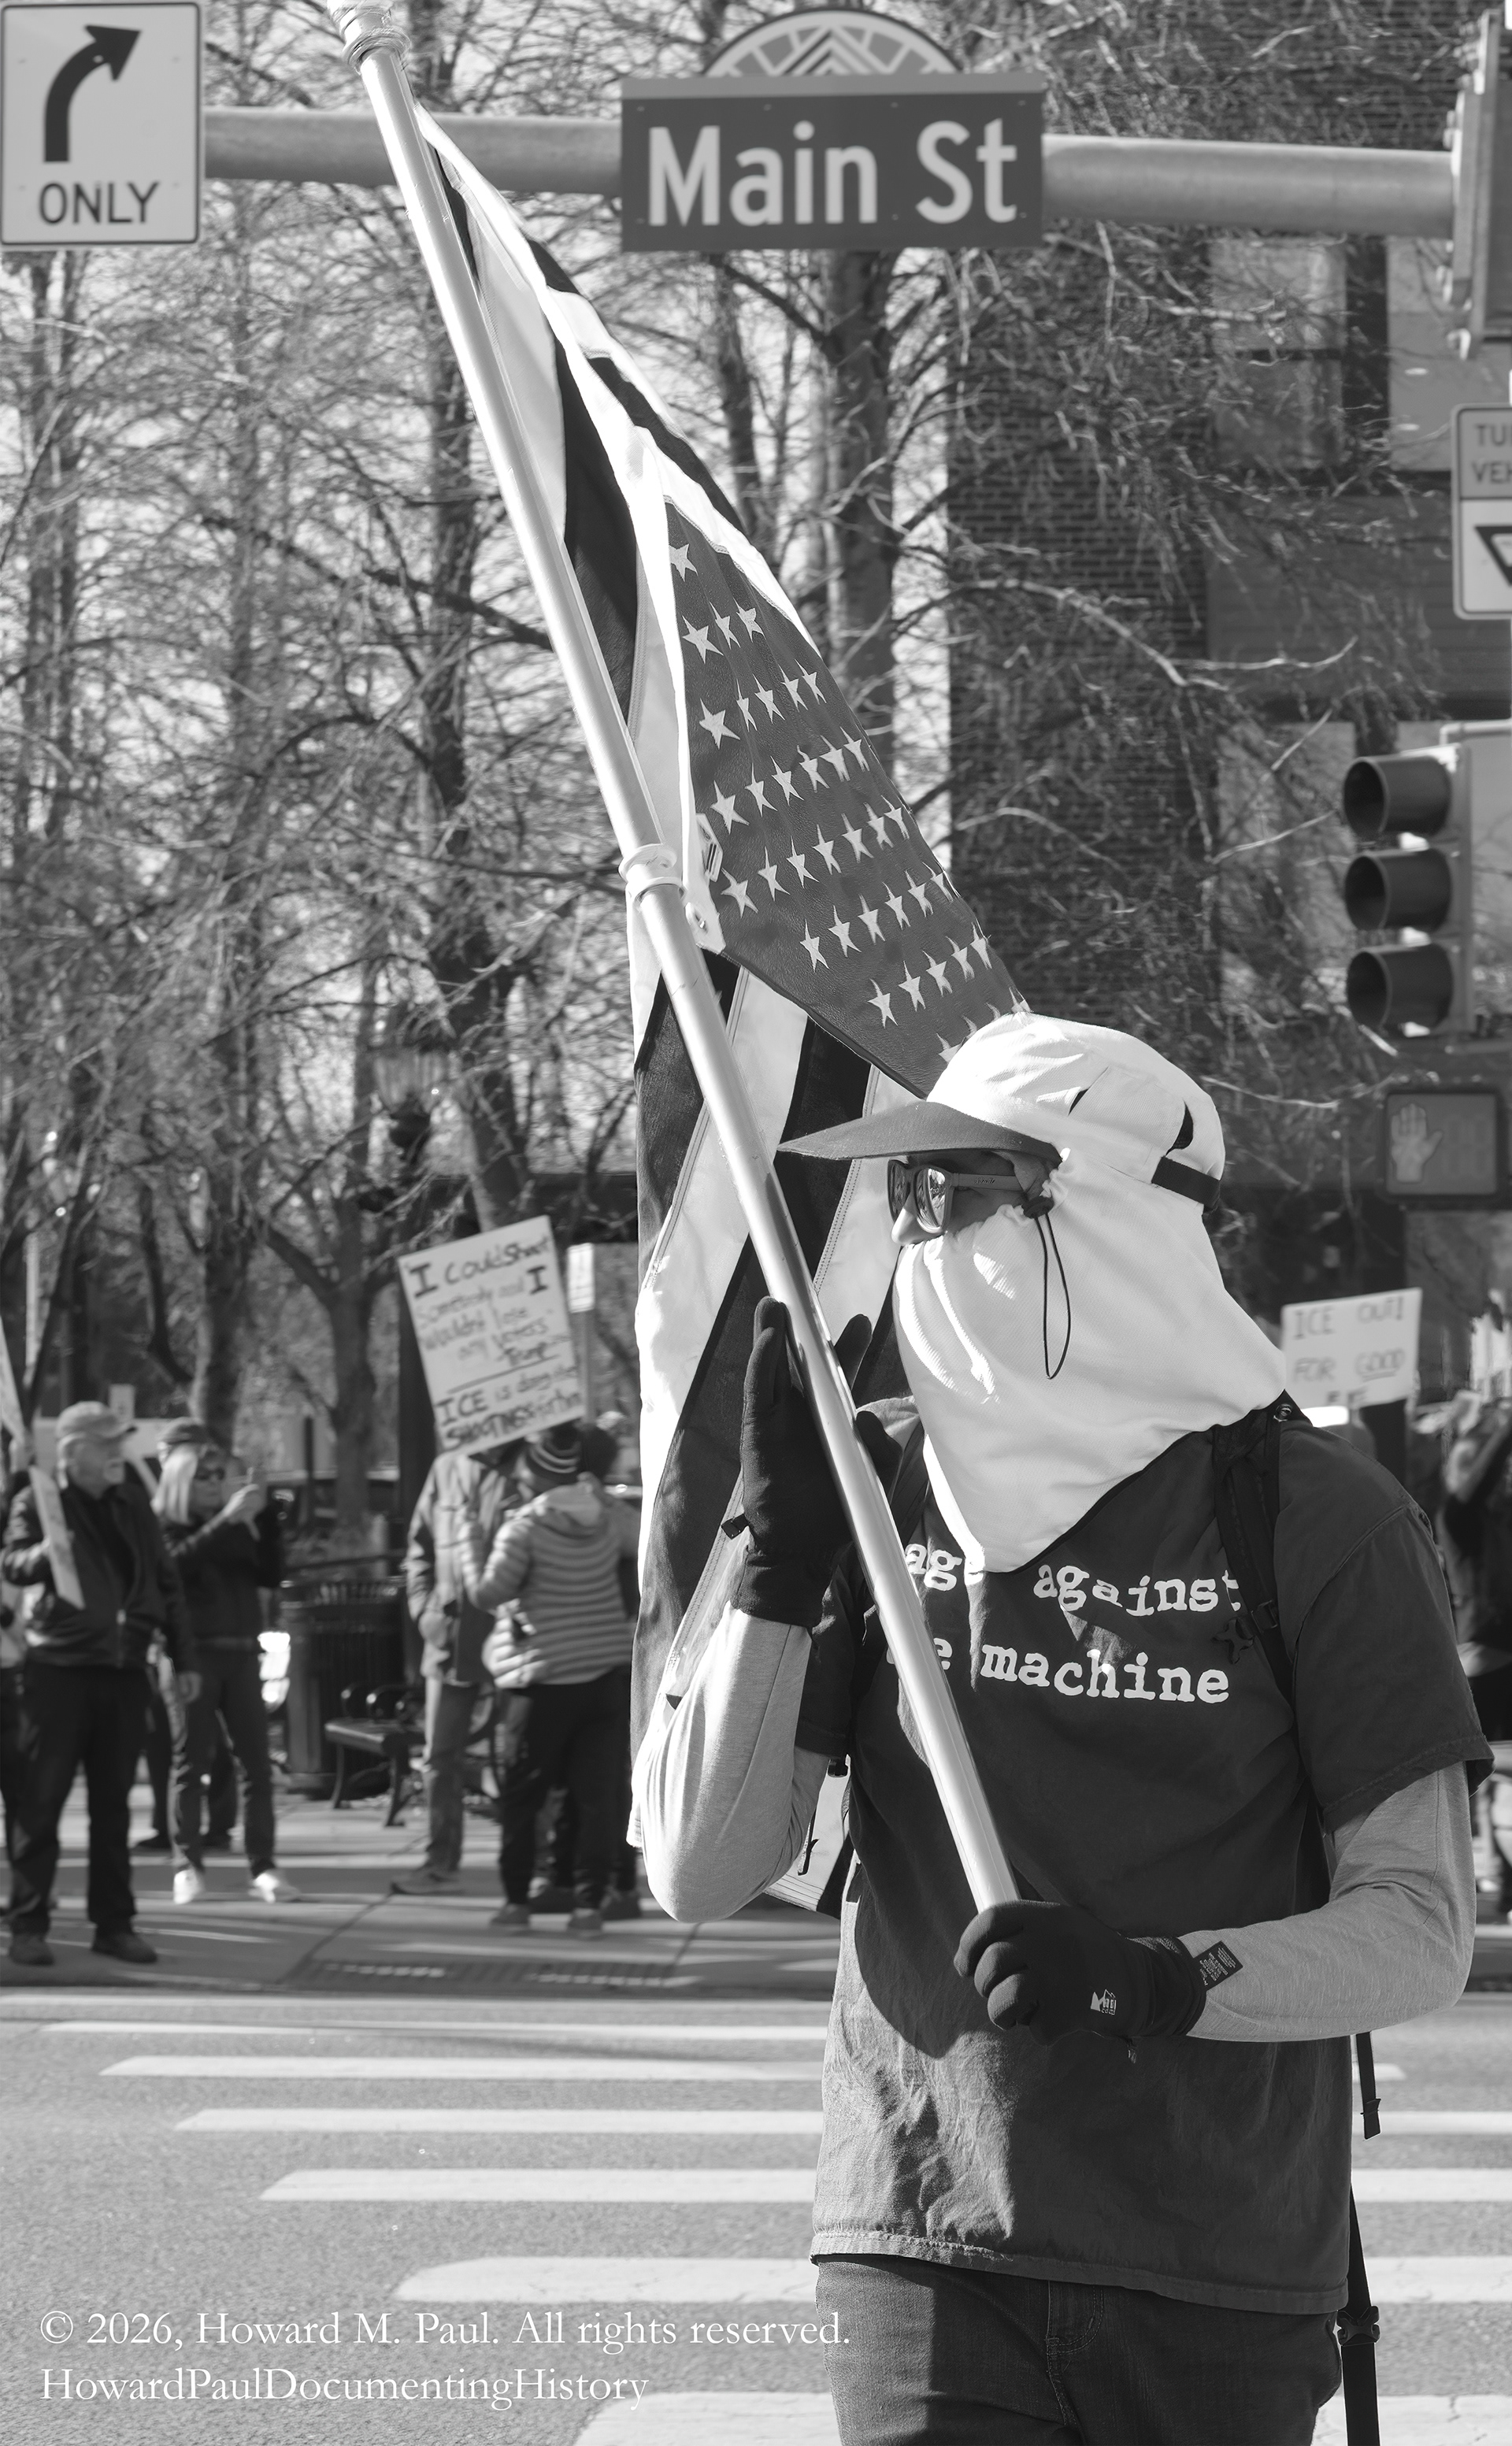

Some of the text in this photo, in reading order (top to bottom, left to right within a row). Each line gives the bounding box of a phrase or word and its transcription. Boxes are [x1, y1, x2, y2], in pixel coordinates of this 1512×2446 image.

[649, 118, 1017, 226] Main St
[39, 182, 158, 224] ONLY
[1474, 423, 1512, 447] TU
[408, 1262, 439, 1299] I
[525, 1265, 549, 1296] I
[1293, 1306, 1336, 1340] ICE
[435, 1388, 489, 1427] ICE
[905, 1544, 1242, 1618] ag against
[980, 1644, 1230, 1705] machine
